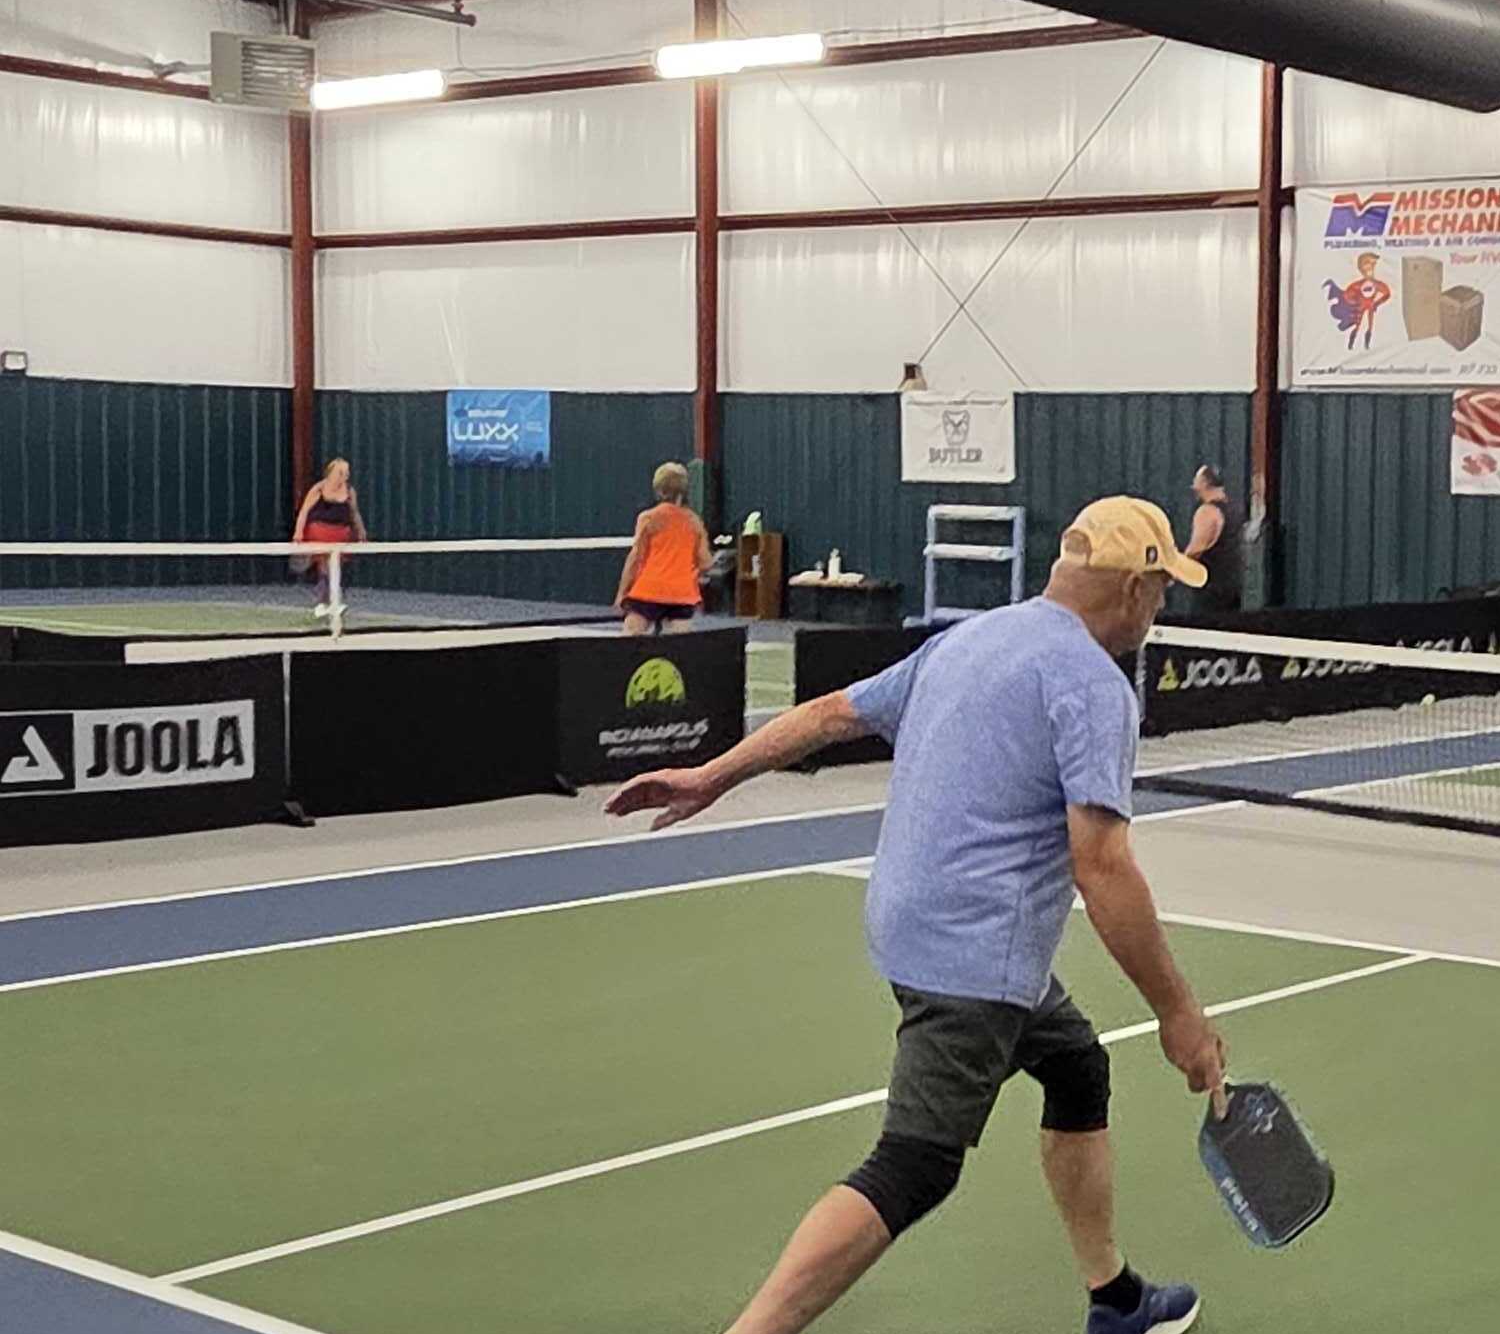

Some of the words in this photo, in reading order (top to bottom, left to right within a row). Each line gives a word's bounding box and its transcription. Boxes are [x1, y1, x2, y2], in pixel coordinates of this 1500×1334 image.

[1449, 251, 1478, 264] Your
[928, 447, 982, 463] BUTLER
[1181, 656, 1263, 690] JOOLA
[86, 715, 245, 778] JOOLA
